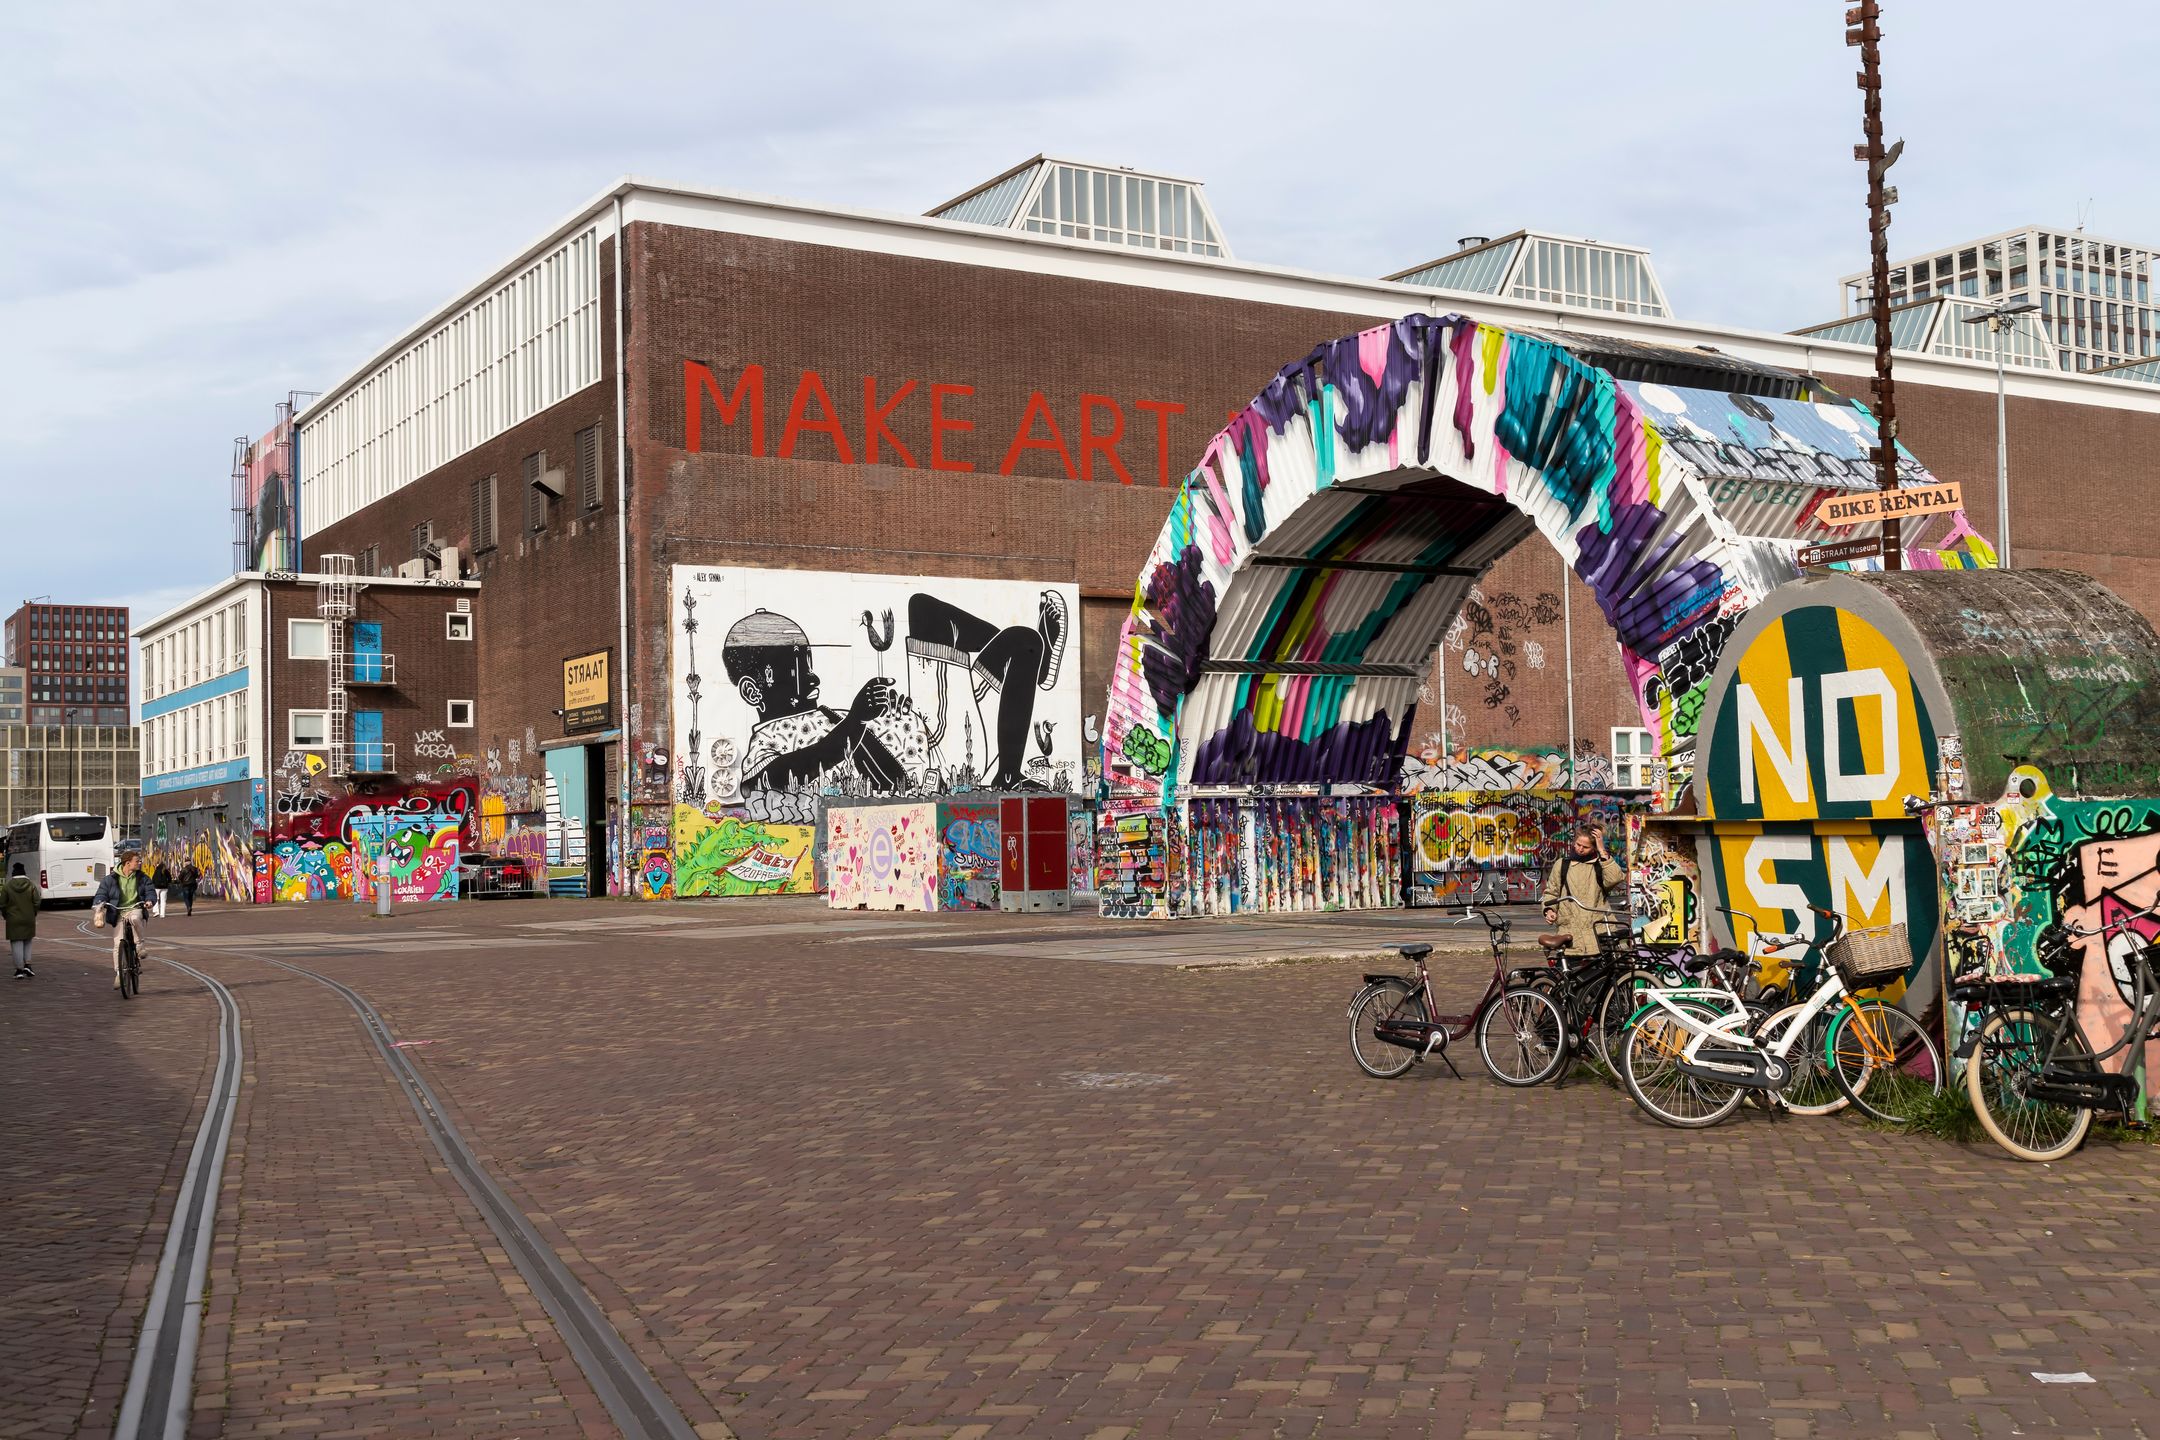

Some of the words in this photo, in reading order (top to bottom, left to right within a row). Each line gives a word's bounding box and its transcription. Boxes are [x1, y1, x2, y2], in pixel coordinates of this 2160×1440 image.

[684, 360, 974, 472] MAKE
[999, 391, 1186, 488] ART
[1828, 499, 1876, 519] BIKE
[1880, 489, 1959, 513] RENTAL
[1821, 548, 1847, 559] STRAAT
[1850, 543, 1878, 555] Museum
[697, 572, 706, 582] ALEX
[568, 660, 604, 685] STRAAT
[415, 729, 445, 743] LACK
[1736, 668, 1900, 804] ND
[414, 744, 457, 759] KORGA
[1024, 767, 1045, 776] NSPS
[389, 824, 394, 832] P
[752, 850, 793, 868] OBEY
[401, 894, 418, 902] 2023
[1744, 835, 1908, 961] SM
